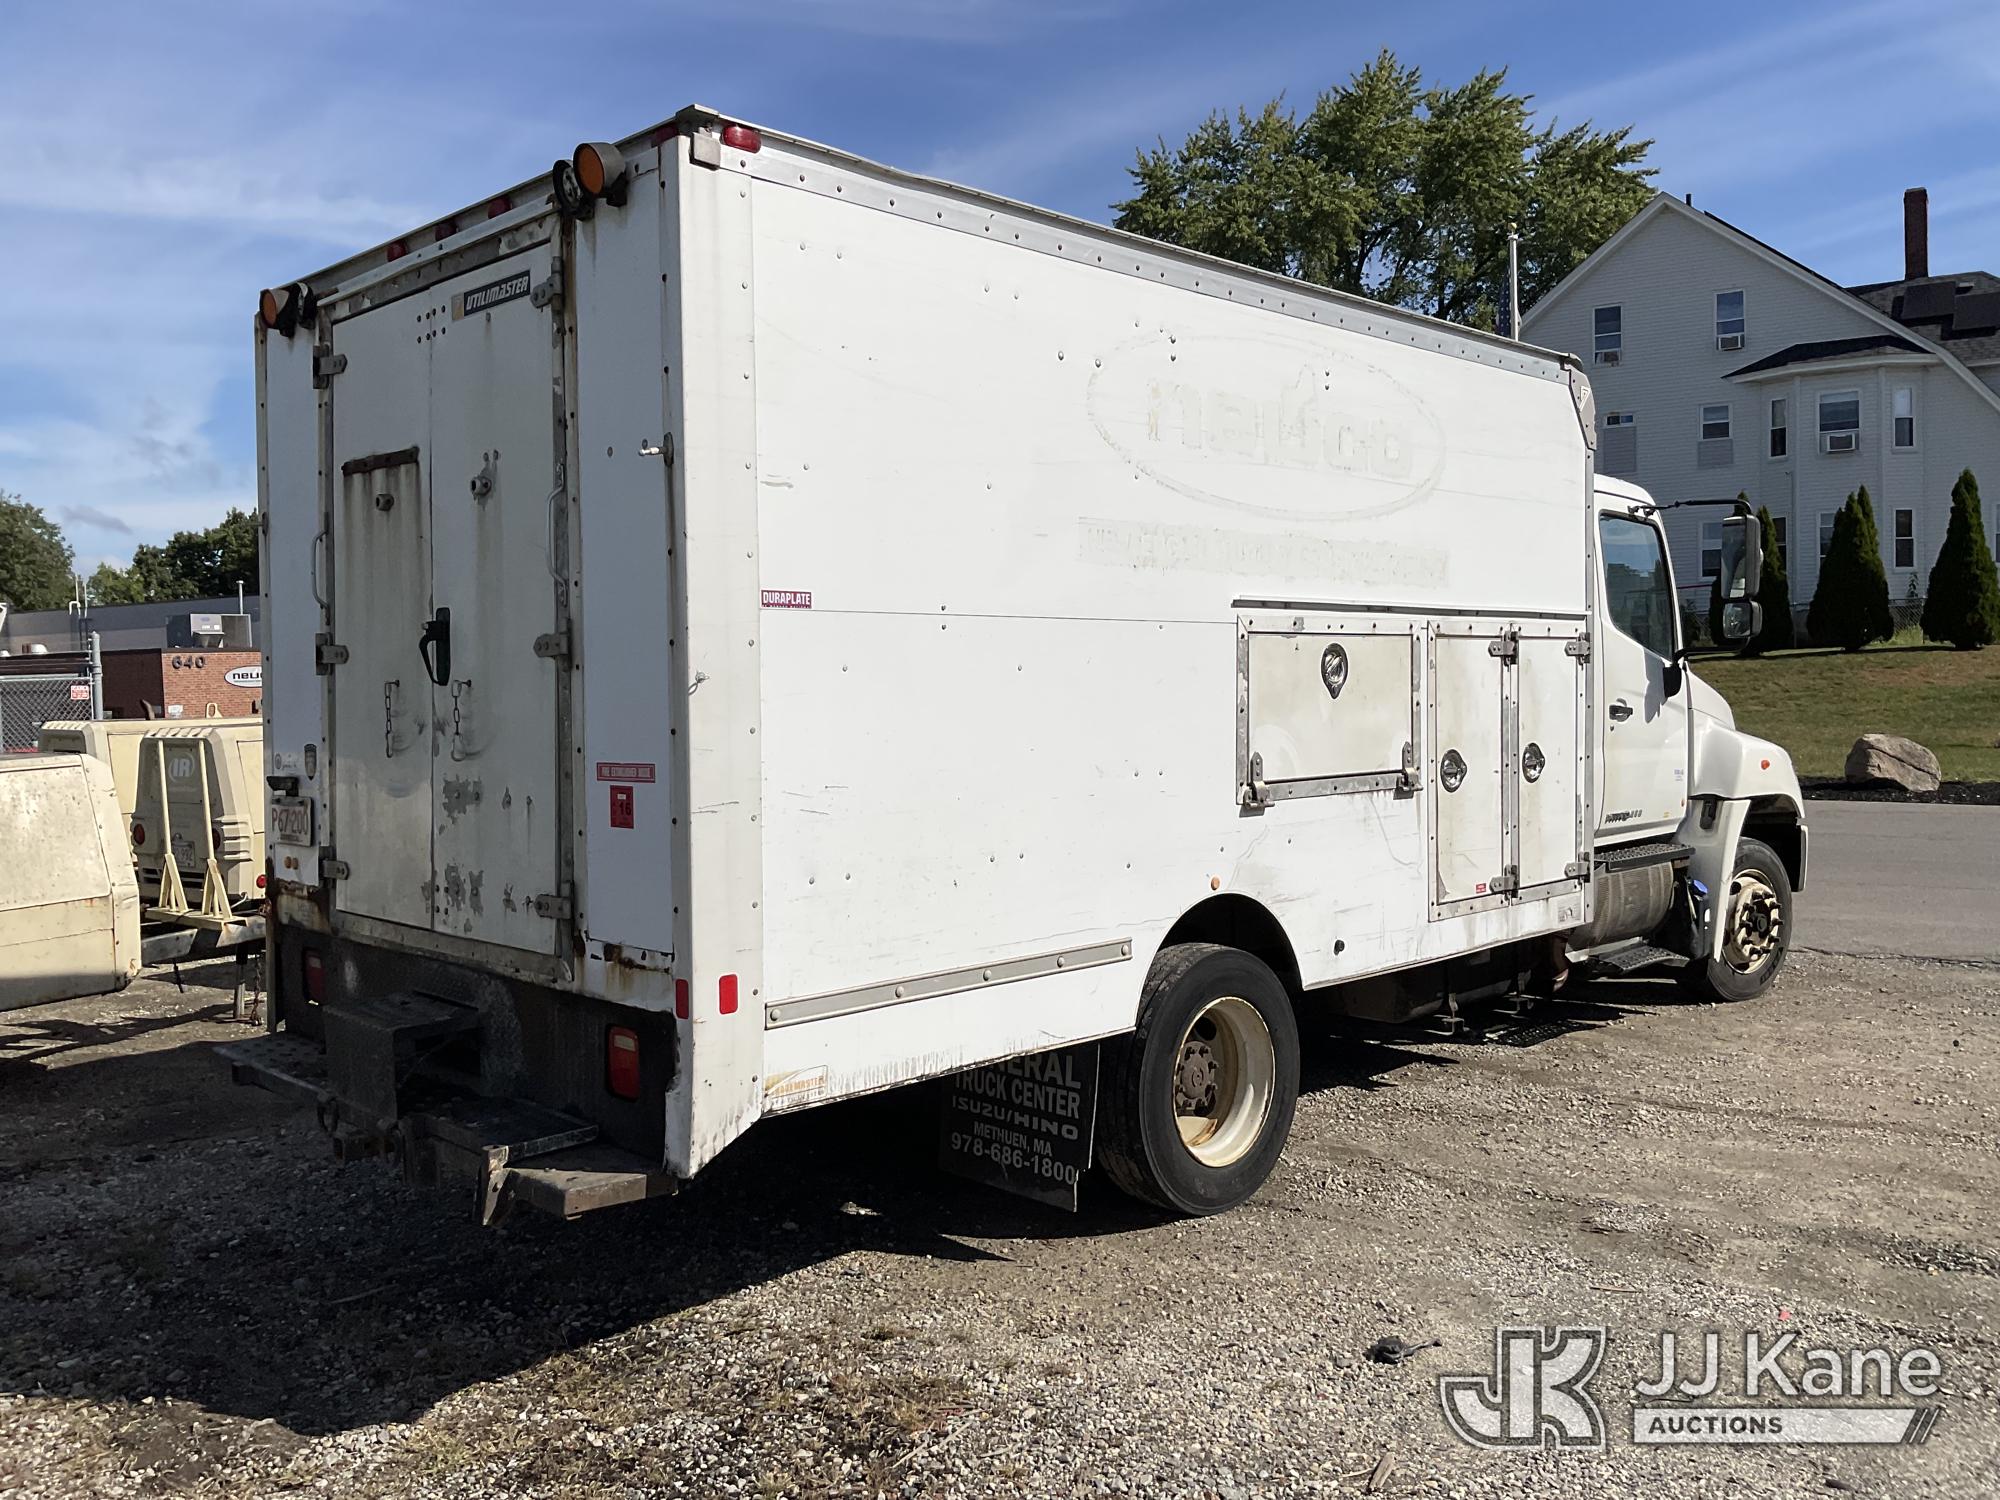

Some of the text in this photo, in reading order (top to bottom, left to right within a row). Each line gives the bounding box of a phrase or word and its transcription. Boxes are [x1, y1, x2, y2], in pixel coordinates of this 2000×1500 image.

[762, 591, 811, 605] DURAPLATE
[172, 655, 206, 670] 640
[232, 672, 262, 680] neu
[990, 1052, 1082, 1090] ERAL
[1011, 1077, 1081, 1120] CENTER
[952, 1095, 1079, 1141] ISUZU/HINO
[973, 1121, 1053, 1158] METHUEN, MA
[951, 1132, 1075, 1185] 978-686-1800
